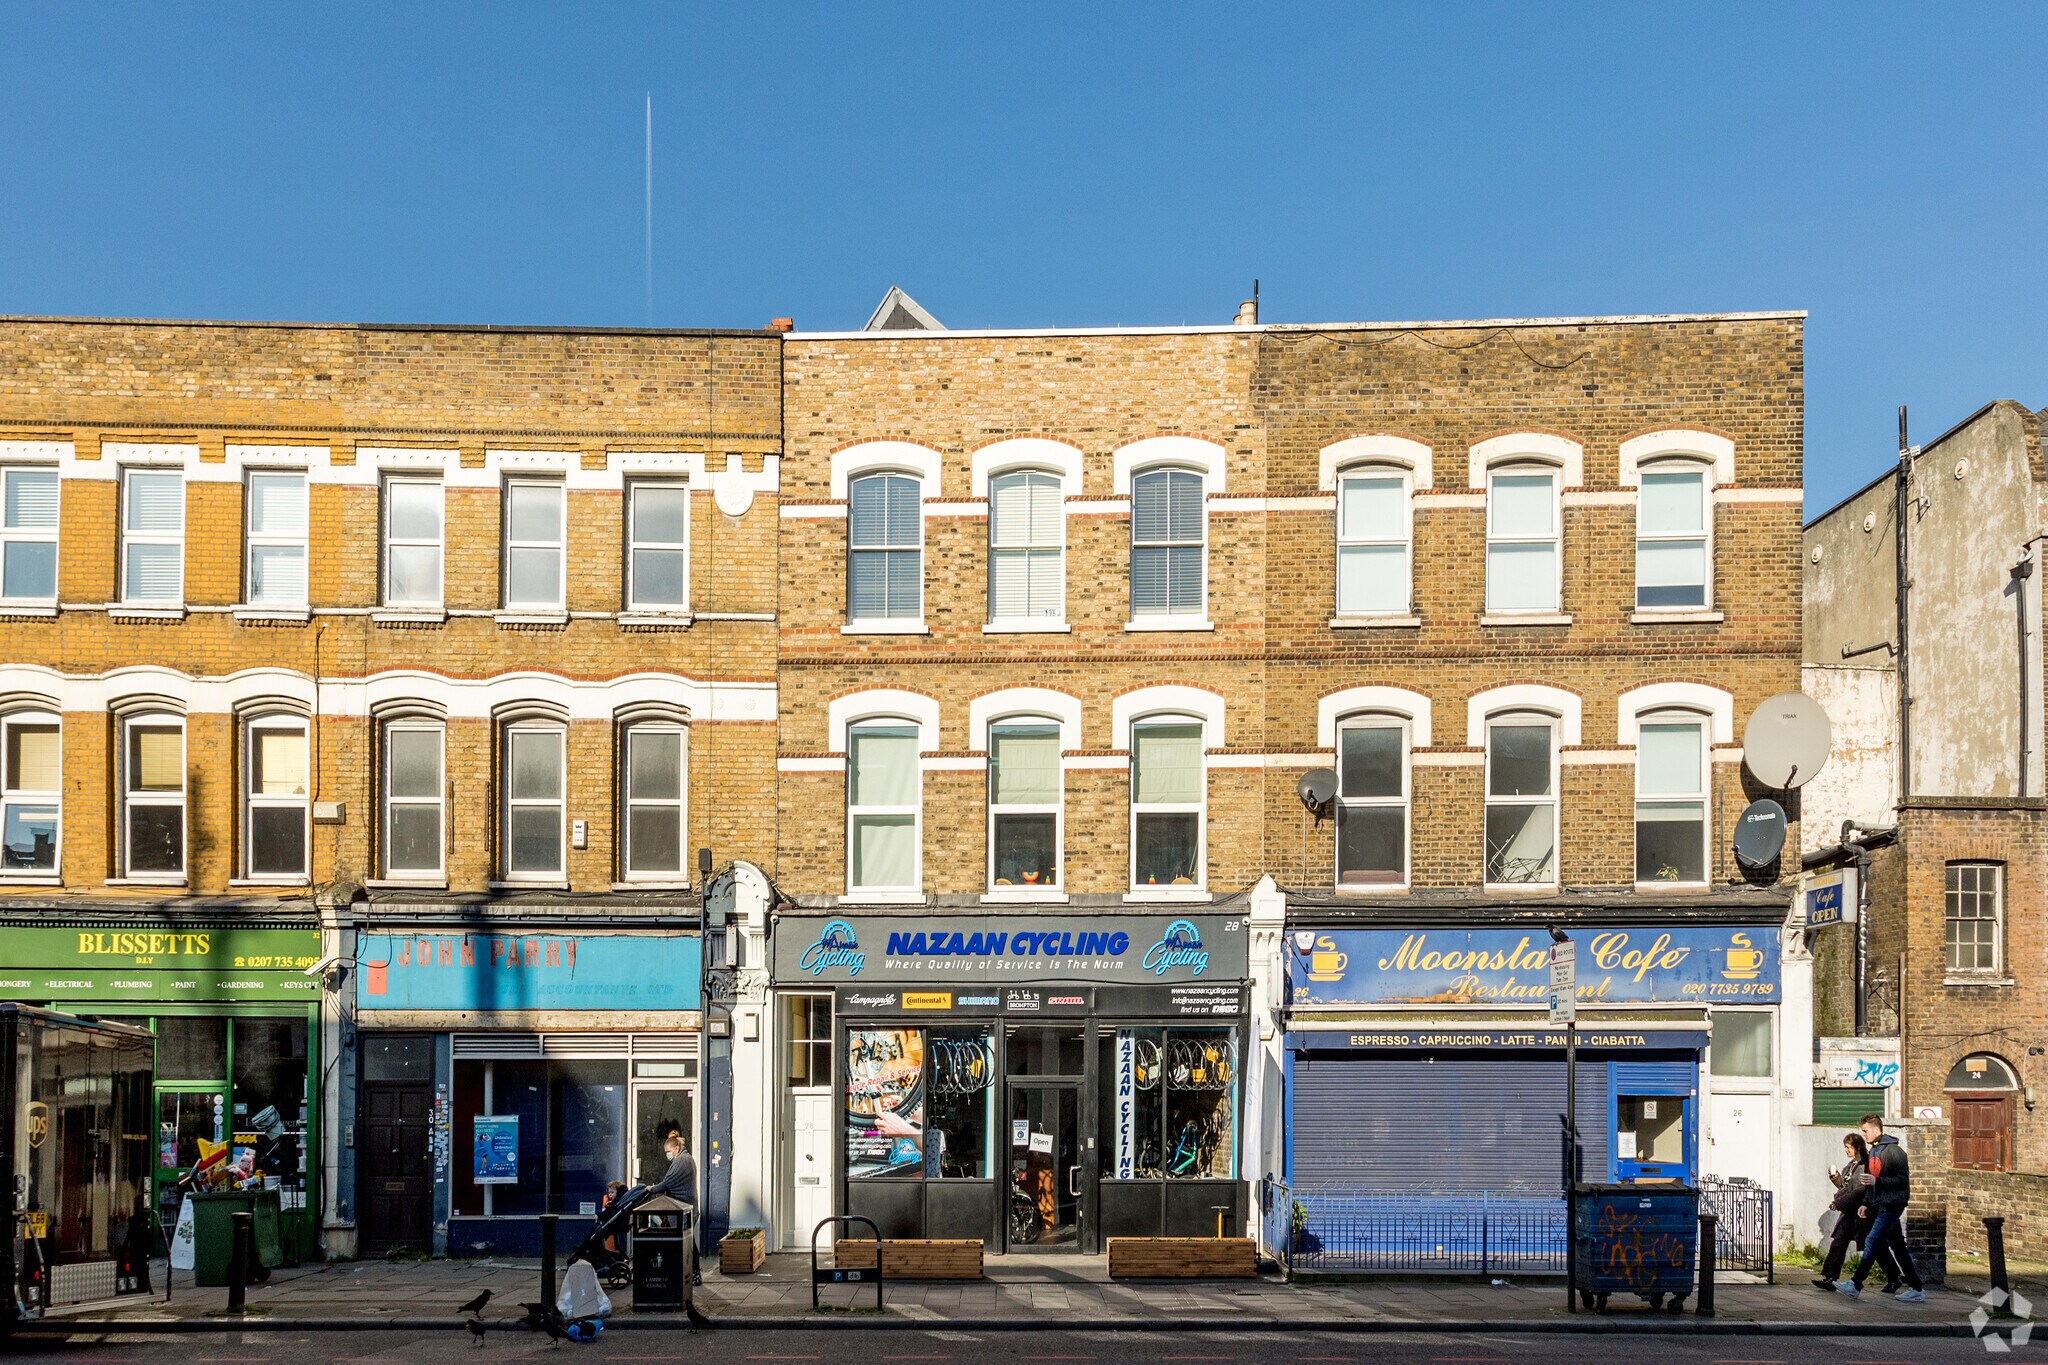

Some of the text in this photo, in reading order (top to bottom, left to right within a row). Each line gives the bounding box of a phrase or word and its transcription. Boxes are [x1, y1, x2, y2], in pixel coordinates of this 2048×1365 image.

[1811, 906, 1839, 923] OPEN
[1224, 921, 1239, 932] 28
[78, 933, 210, 955] BLISSETTS
[886, 931, 1130, 956] NAZAAN CYCLING
[397, 939, 579, 967] JOHN PARRY
[800, 940, 866, 976] Cycling
[1142, 940, 1210, 976] Cycling
[1378, 933, 1550, 971] Moonsta
[248, 956, 271, 968] 0207
[275, 956, 293, 968] 735
[885, 959, 922, 969] Where
[928, 959, 972, 971] Quality
[978, 959, 992, 969] of
[996, 959, 1043, 969] Service
[1067, 959, 1088, 969] The
[1093, 959, 1124, 969] Norm
[49, 980, 94, 988] ELECTRICAL
[114, 980, 153, 988] PLUMBING
[175, 981, 197, 989] PAINT
[221, 981, 264, 989] GARDENING
[284, 981, 303, 989] KEYS
[1682, 983, 1774, 996] 020 7735 9789
[1171, 987, 1239, 996] www.nazaancycling.com
[1294, 986, 1310, 998] 26
[906, 996, 942, 1005] Continental
[1009, 1001, 1038, 1009] BROMPTON
[1351, 1035, 1646, 1046] ESPRESSO CAPPUCCINO LATTE PANI CIABATTA
[867, 1074, 889, 1086] Repair
[897, 1065, 921, 1077] Service
[1971, 1071, 1982, 1080] 24
[1119, 1028, 1133, 1180] NAZAAN CYCLING
[1733, 1108, 1743, 1118] 26
[26, 1115, 47, 1141] ups
[1033, 1137, 1049, 1146] Open
[835, 1272, 841, 1280] P
